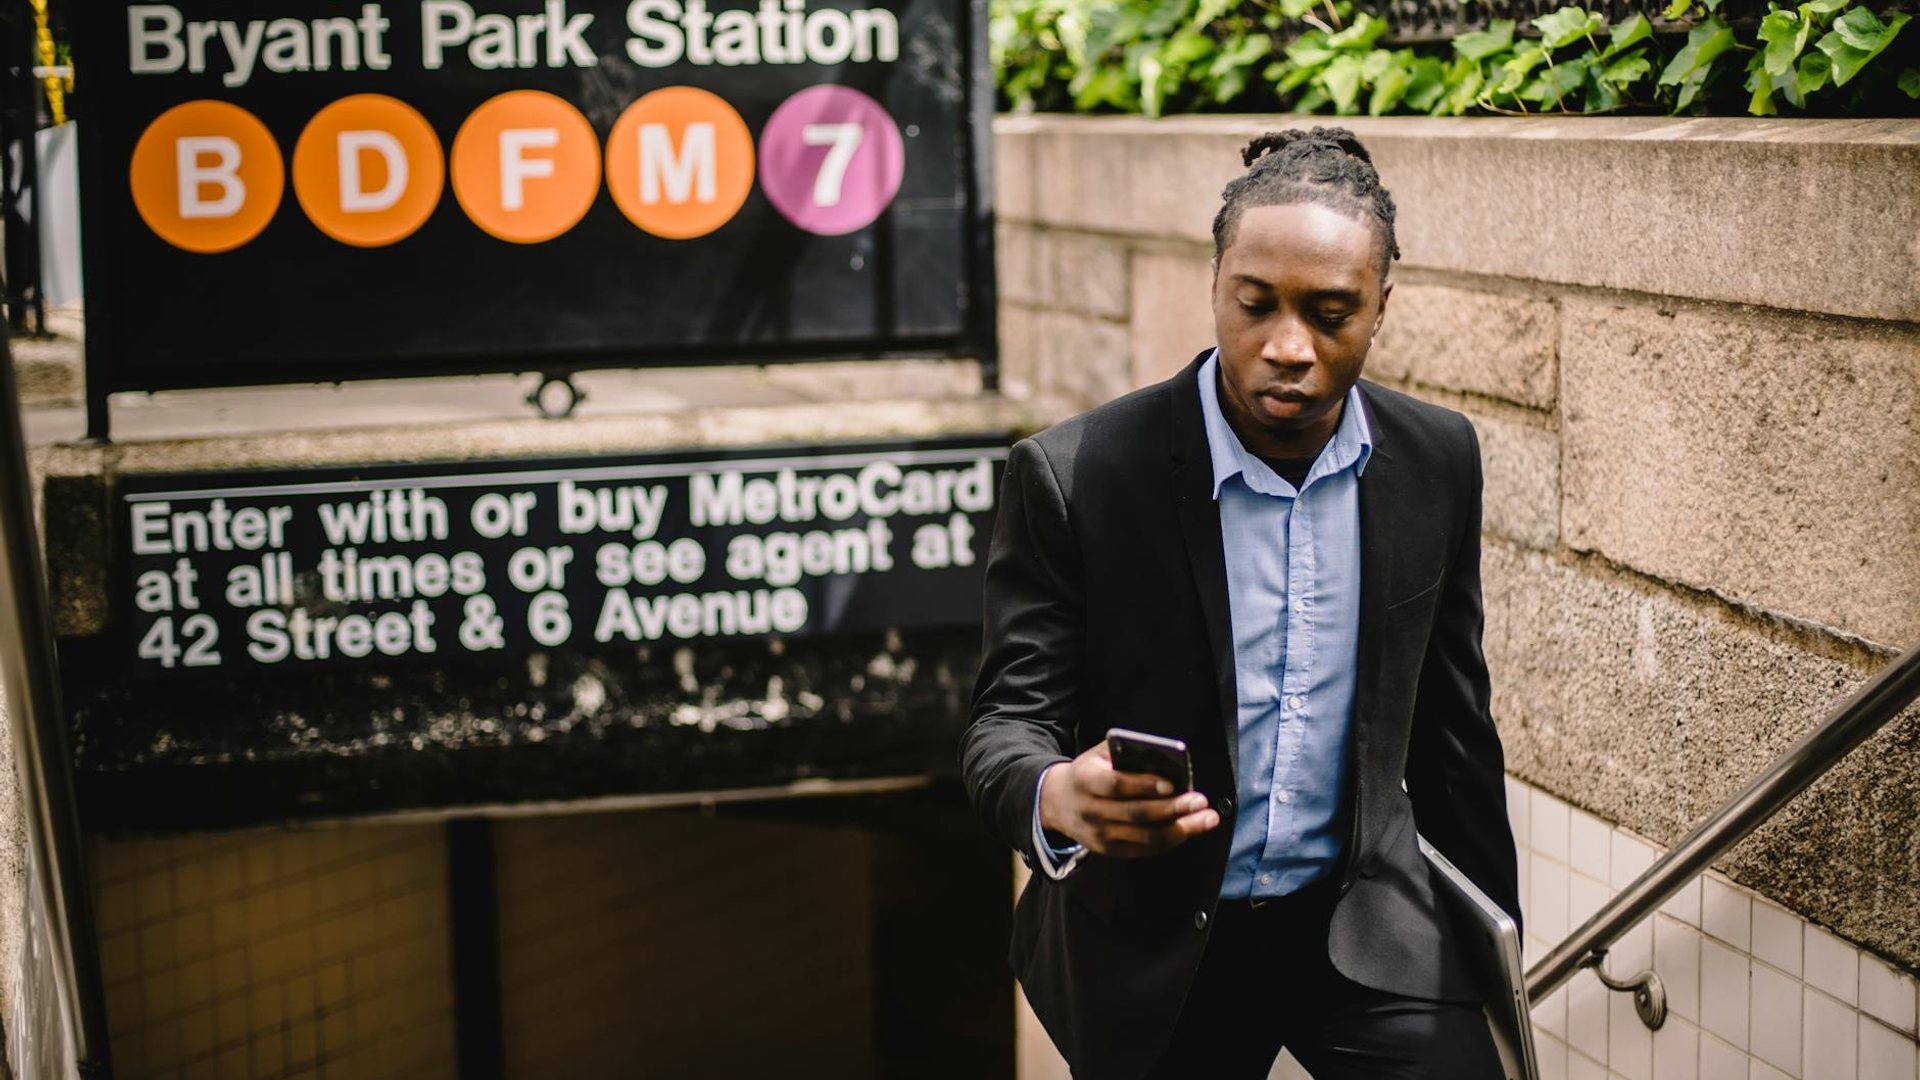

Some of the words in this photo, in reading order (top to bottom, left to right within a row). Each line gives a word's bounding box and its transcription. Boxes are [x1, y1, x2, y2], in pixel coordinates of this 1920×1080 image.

[129, 3, 392, 87] Bryant
[421, 0, 599, 69] Park
[625, 0, 899, 68] Station
[176, 136, 245, 218] B
[337, 130, 408, 212] D
[499, 128, 561, 211] F
[637, 121, 718, 205] M
[803, 123, 863, 206] 7
[130, 498, 293, 555] Enter
[318, 487, 450, 546] with
[470, 491, 537, 539] or
[557, 478, 668, 540] buy
[688, 457, 994, 528] MetroCard
[136, 558, 199, 612] at
[225, 551, 294, 607] all
[318, 547, 487, 602] times
[507, 545, 574, 593] or
[595, 537, 706, 587] see
[725, 517, 894, 587] agent
[911, 512, 976, 570] at
[138, 613, 221, 668] 42
[246, 599, 437, 664] Street
[458, 593, 505, 652] &
[527, 590, 573, 646] 6
[594, 587, 808, 643] Avenue
